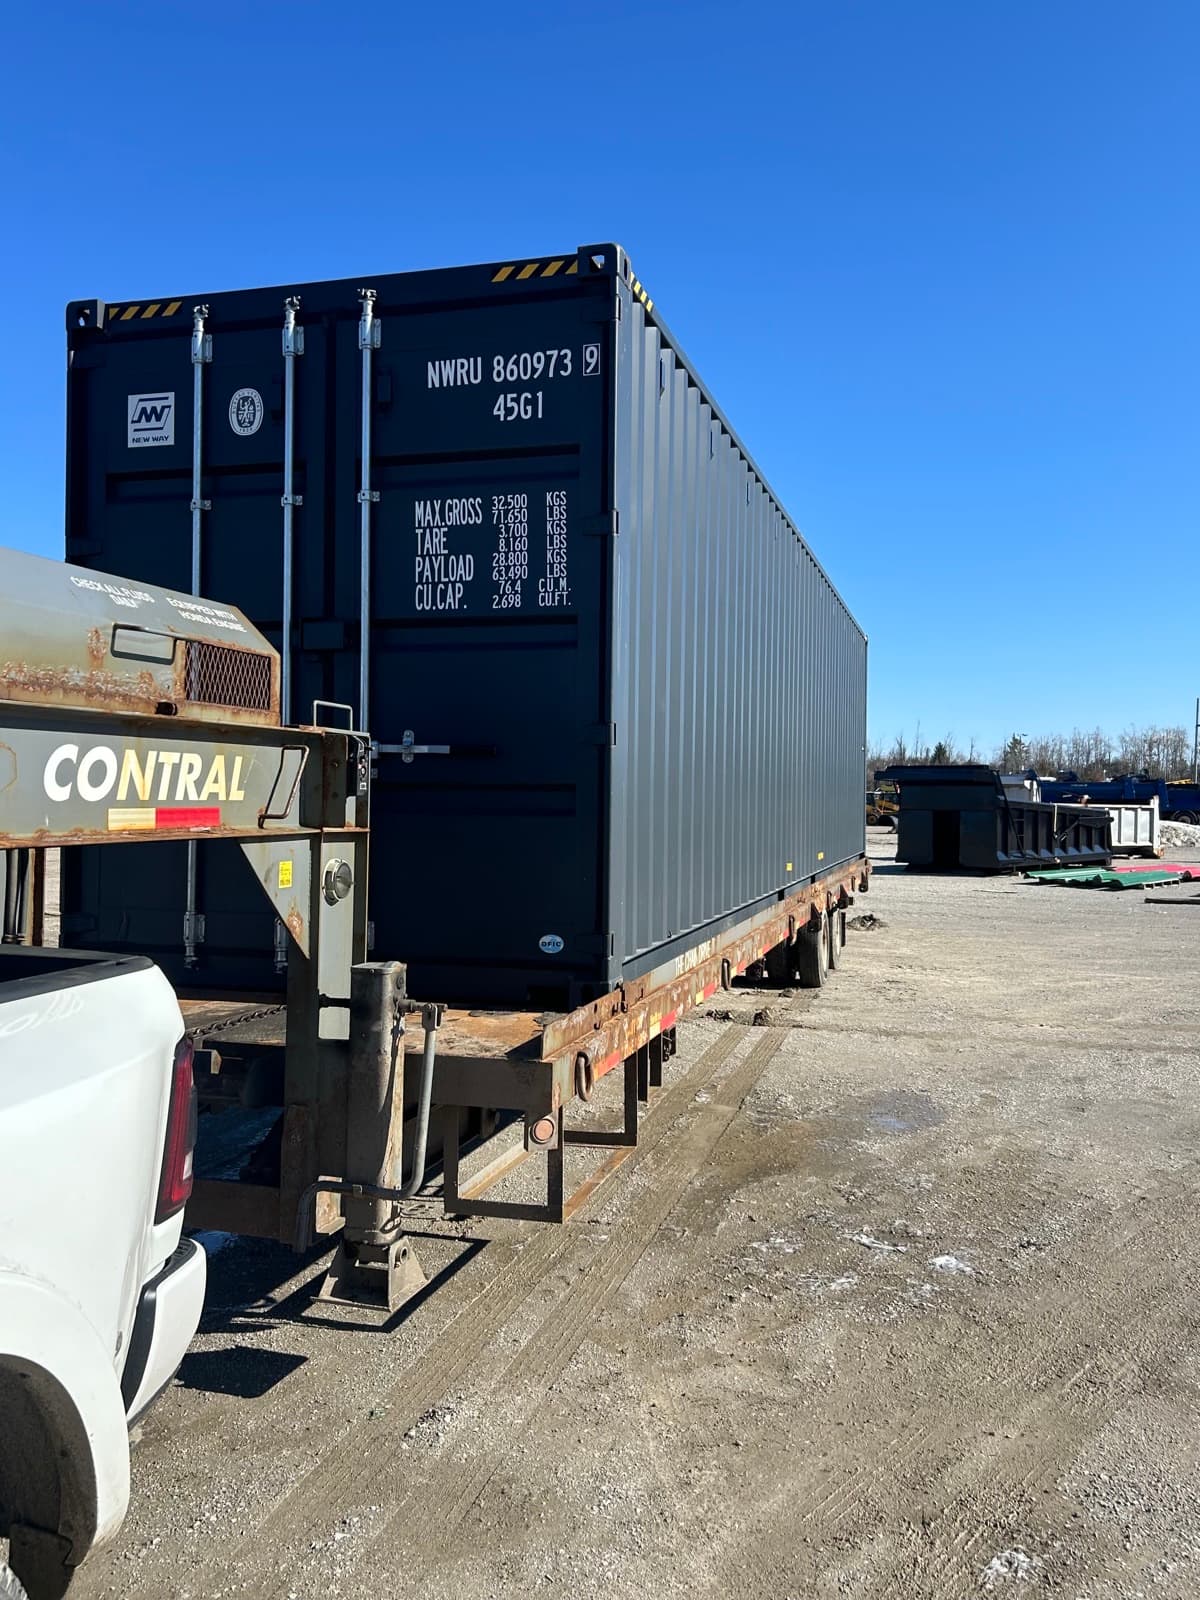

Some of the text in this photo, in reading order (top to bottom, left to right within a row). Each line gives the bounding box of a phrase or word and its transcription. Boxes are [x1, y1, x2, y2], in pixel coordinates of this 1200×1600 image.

[427, 346, 598, 388] NWRU 860973 9
[493, 391, 543, 421] 45G1
[415, 498, 483, 528] MAX.GROSS
[546, 491, 567, 506] KGS
[546, 505, 567, 520] LBS
[415, 528, 449, 556] TARE
[546, 520, 567, 535] KGS
[546, 534, 567, 549] LBS
[415, 554, 474, 583] PAYLOAD
[546, 549, 567, 564] KGS
[546, 563, 567, 578] LBS
[415, 583, 467, 611] CU.CAP.
[498, 579, 521, 595] 76.4
[43, 743, 246, 802] CONTRAL
